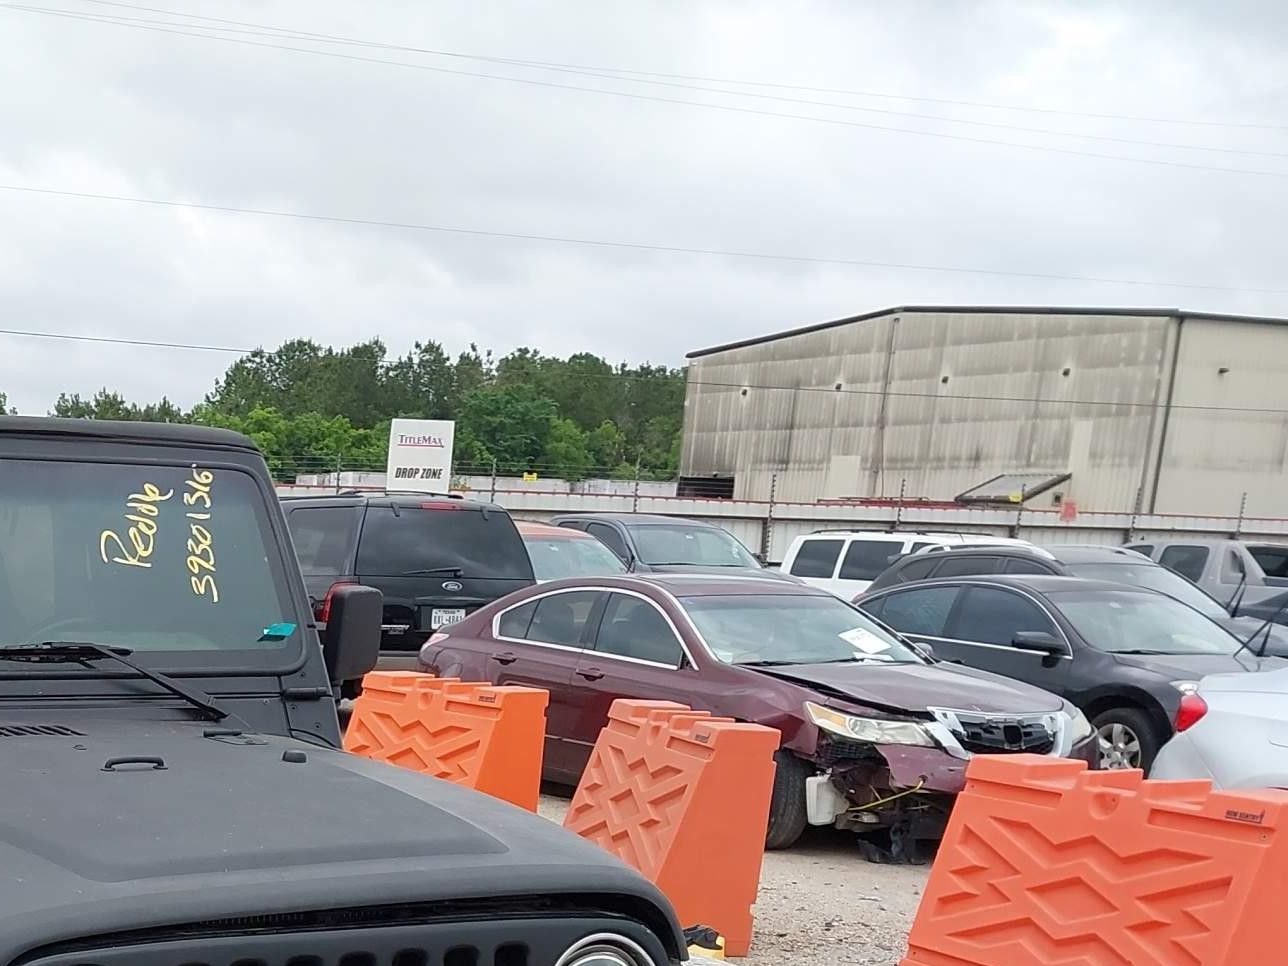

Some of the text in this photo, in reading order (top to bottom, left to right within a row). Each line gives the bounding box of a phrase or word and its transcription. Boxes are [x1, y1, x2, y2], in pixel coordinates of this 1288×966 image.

[395, 467, 444, 480] DROP ZONE
[183, 464, 219, 603] 39301316
